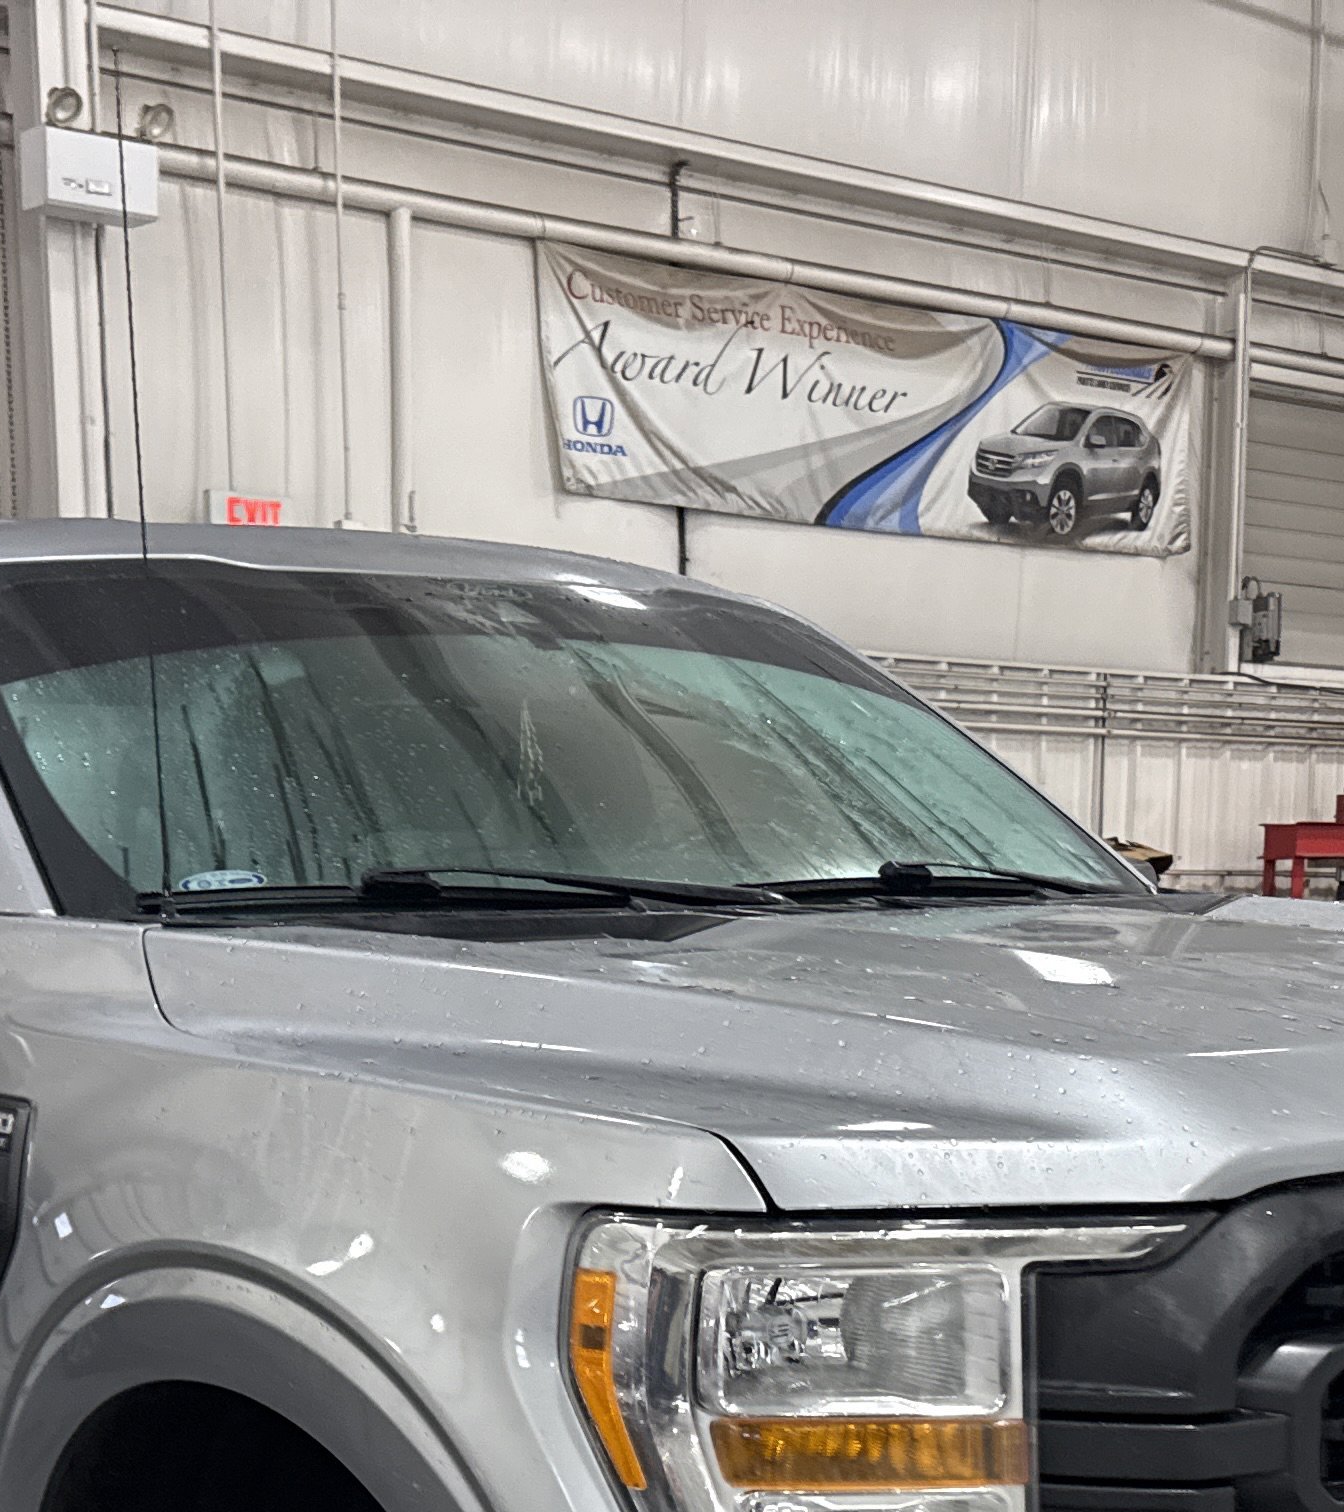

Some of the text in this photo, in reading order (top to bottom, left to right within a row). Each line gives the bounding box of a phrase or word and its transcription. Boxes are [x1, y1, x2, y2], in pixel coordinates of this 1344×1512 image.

[567, 268, 896, 353] Customer Service Experience
[553, 319, 908, 414] Award Winner
[562, 438, 628, 457] HONDA
